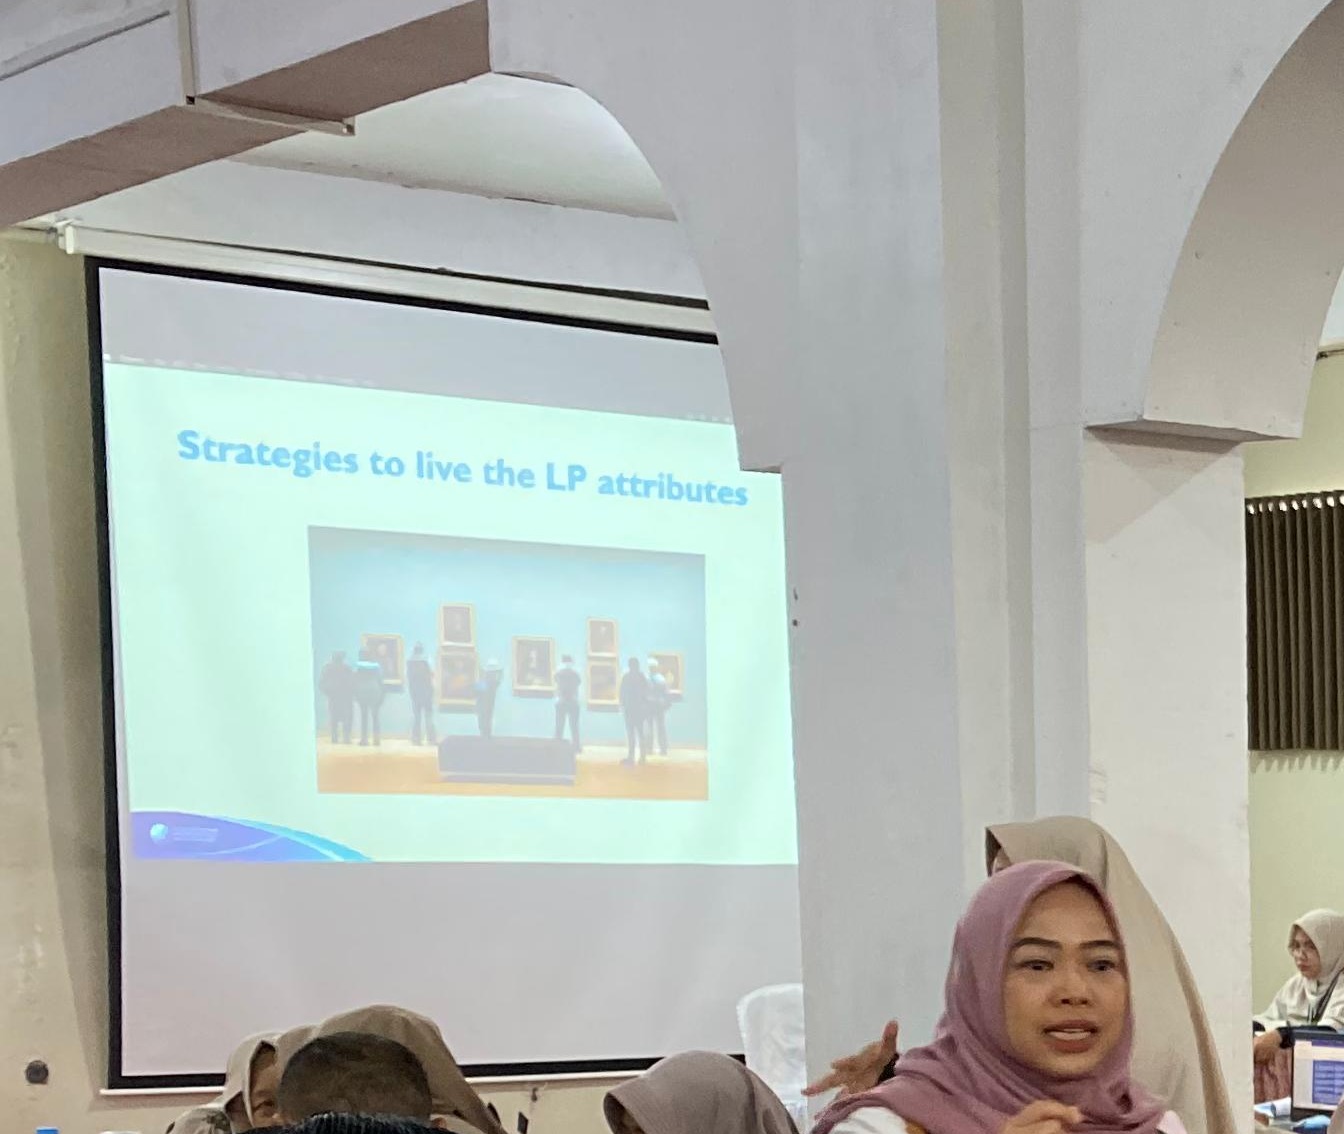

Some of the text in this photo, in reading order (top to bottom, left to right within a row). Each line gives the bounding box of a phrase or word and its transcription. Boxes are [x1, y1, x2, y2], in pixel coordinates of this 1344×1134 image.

[177, 429, 748, 506] Strategies to live the LP attributes
